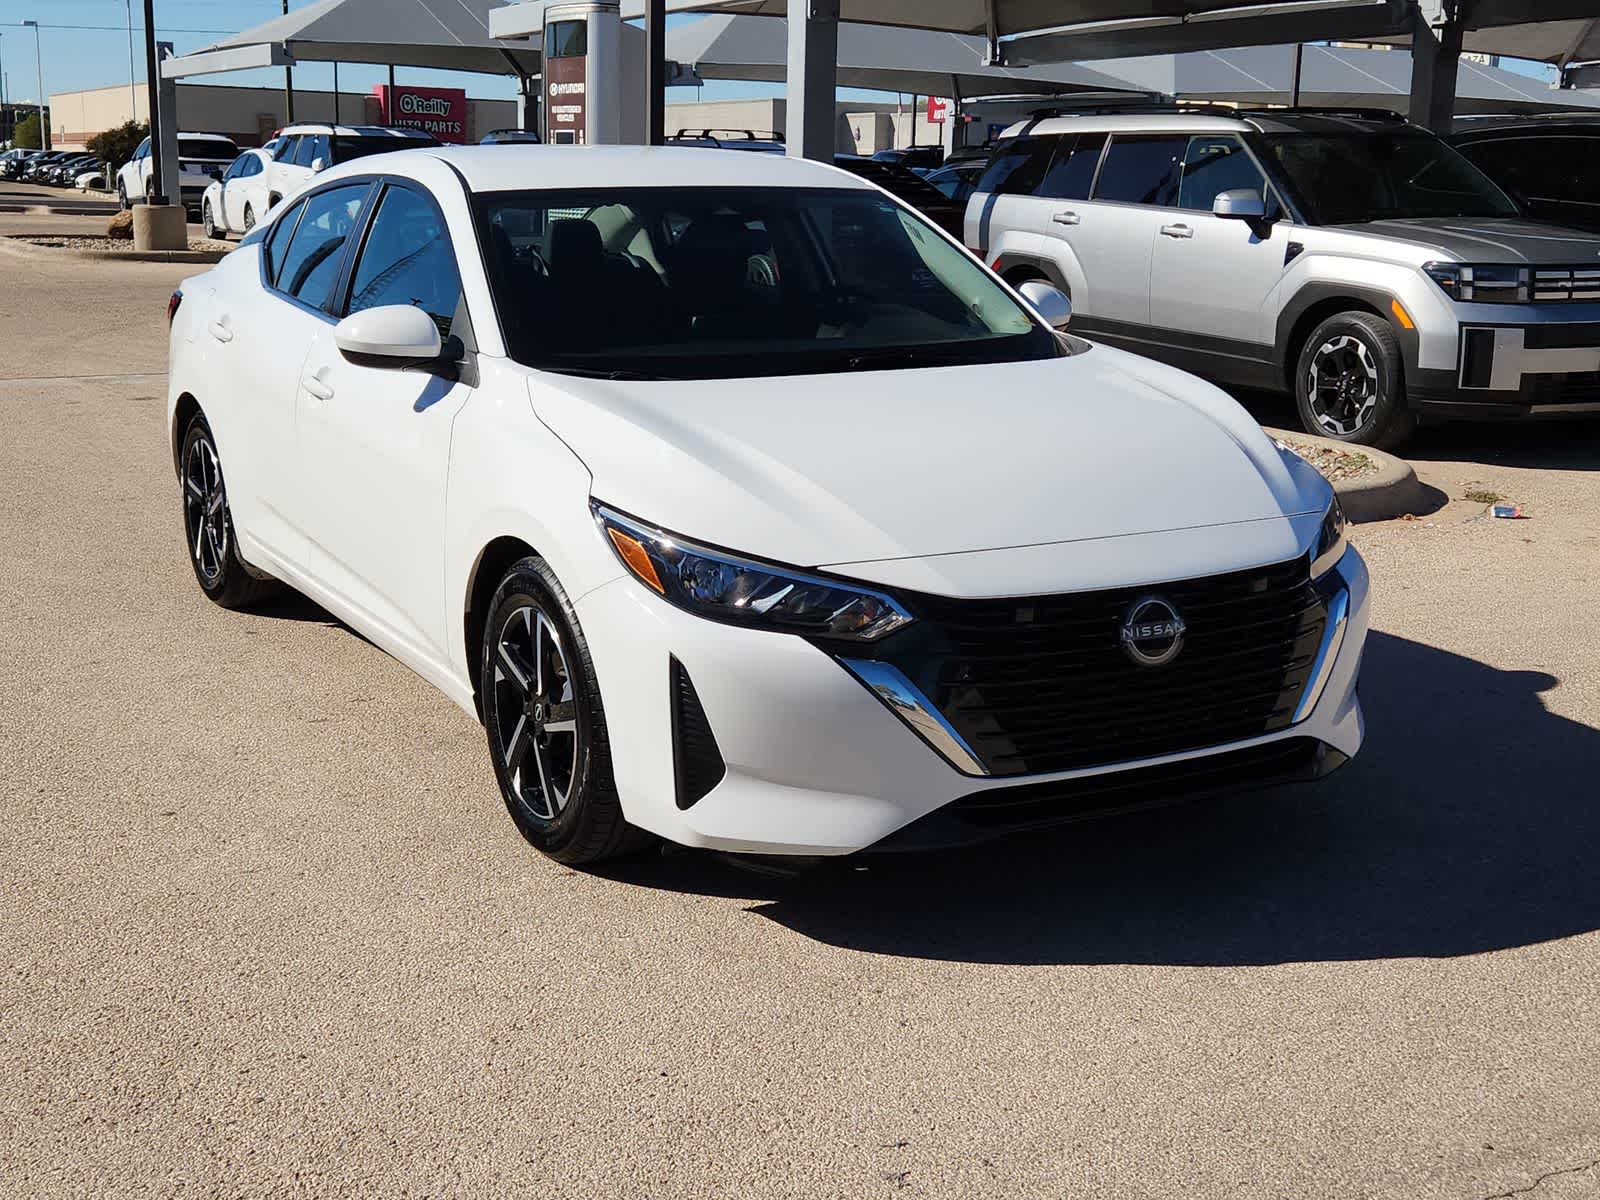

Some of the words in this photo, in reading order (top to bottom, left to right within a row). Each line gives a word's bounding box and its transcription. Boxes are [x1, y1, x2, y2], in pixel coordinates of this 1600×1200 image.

[400, 94, 451, 117] O'Reilly
[425, 121, 462, 134] PARTS
[1122, 621, 1184, 638] NISSAN
